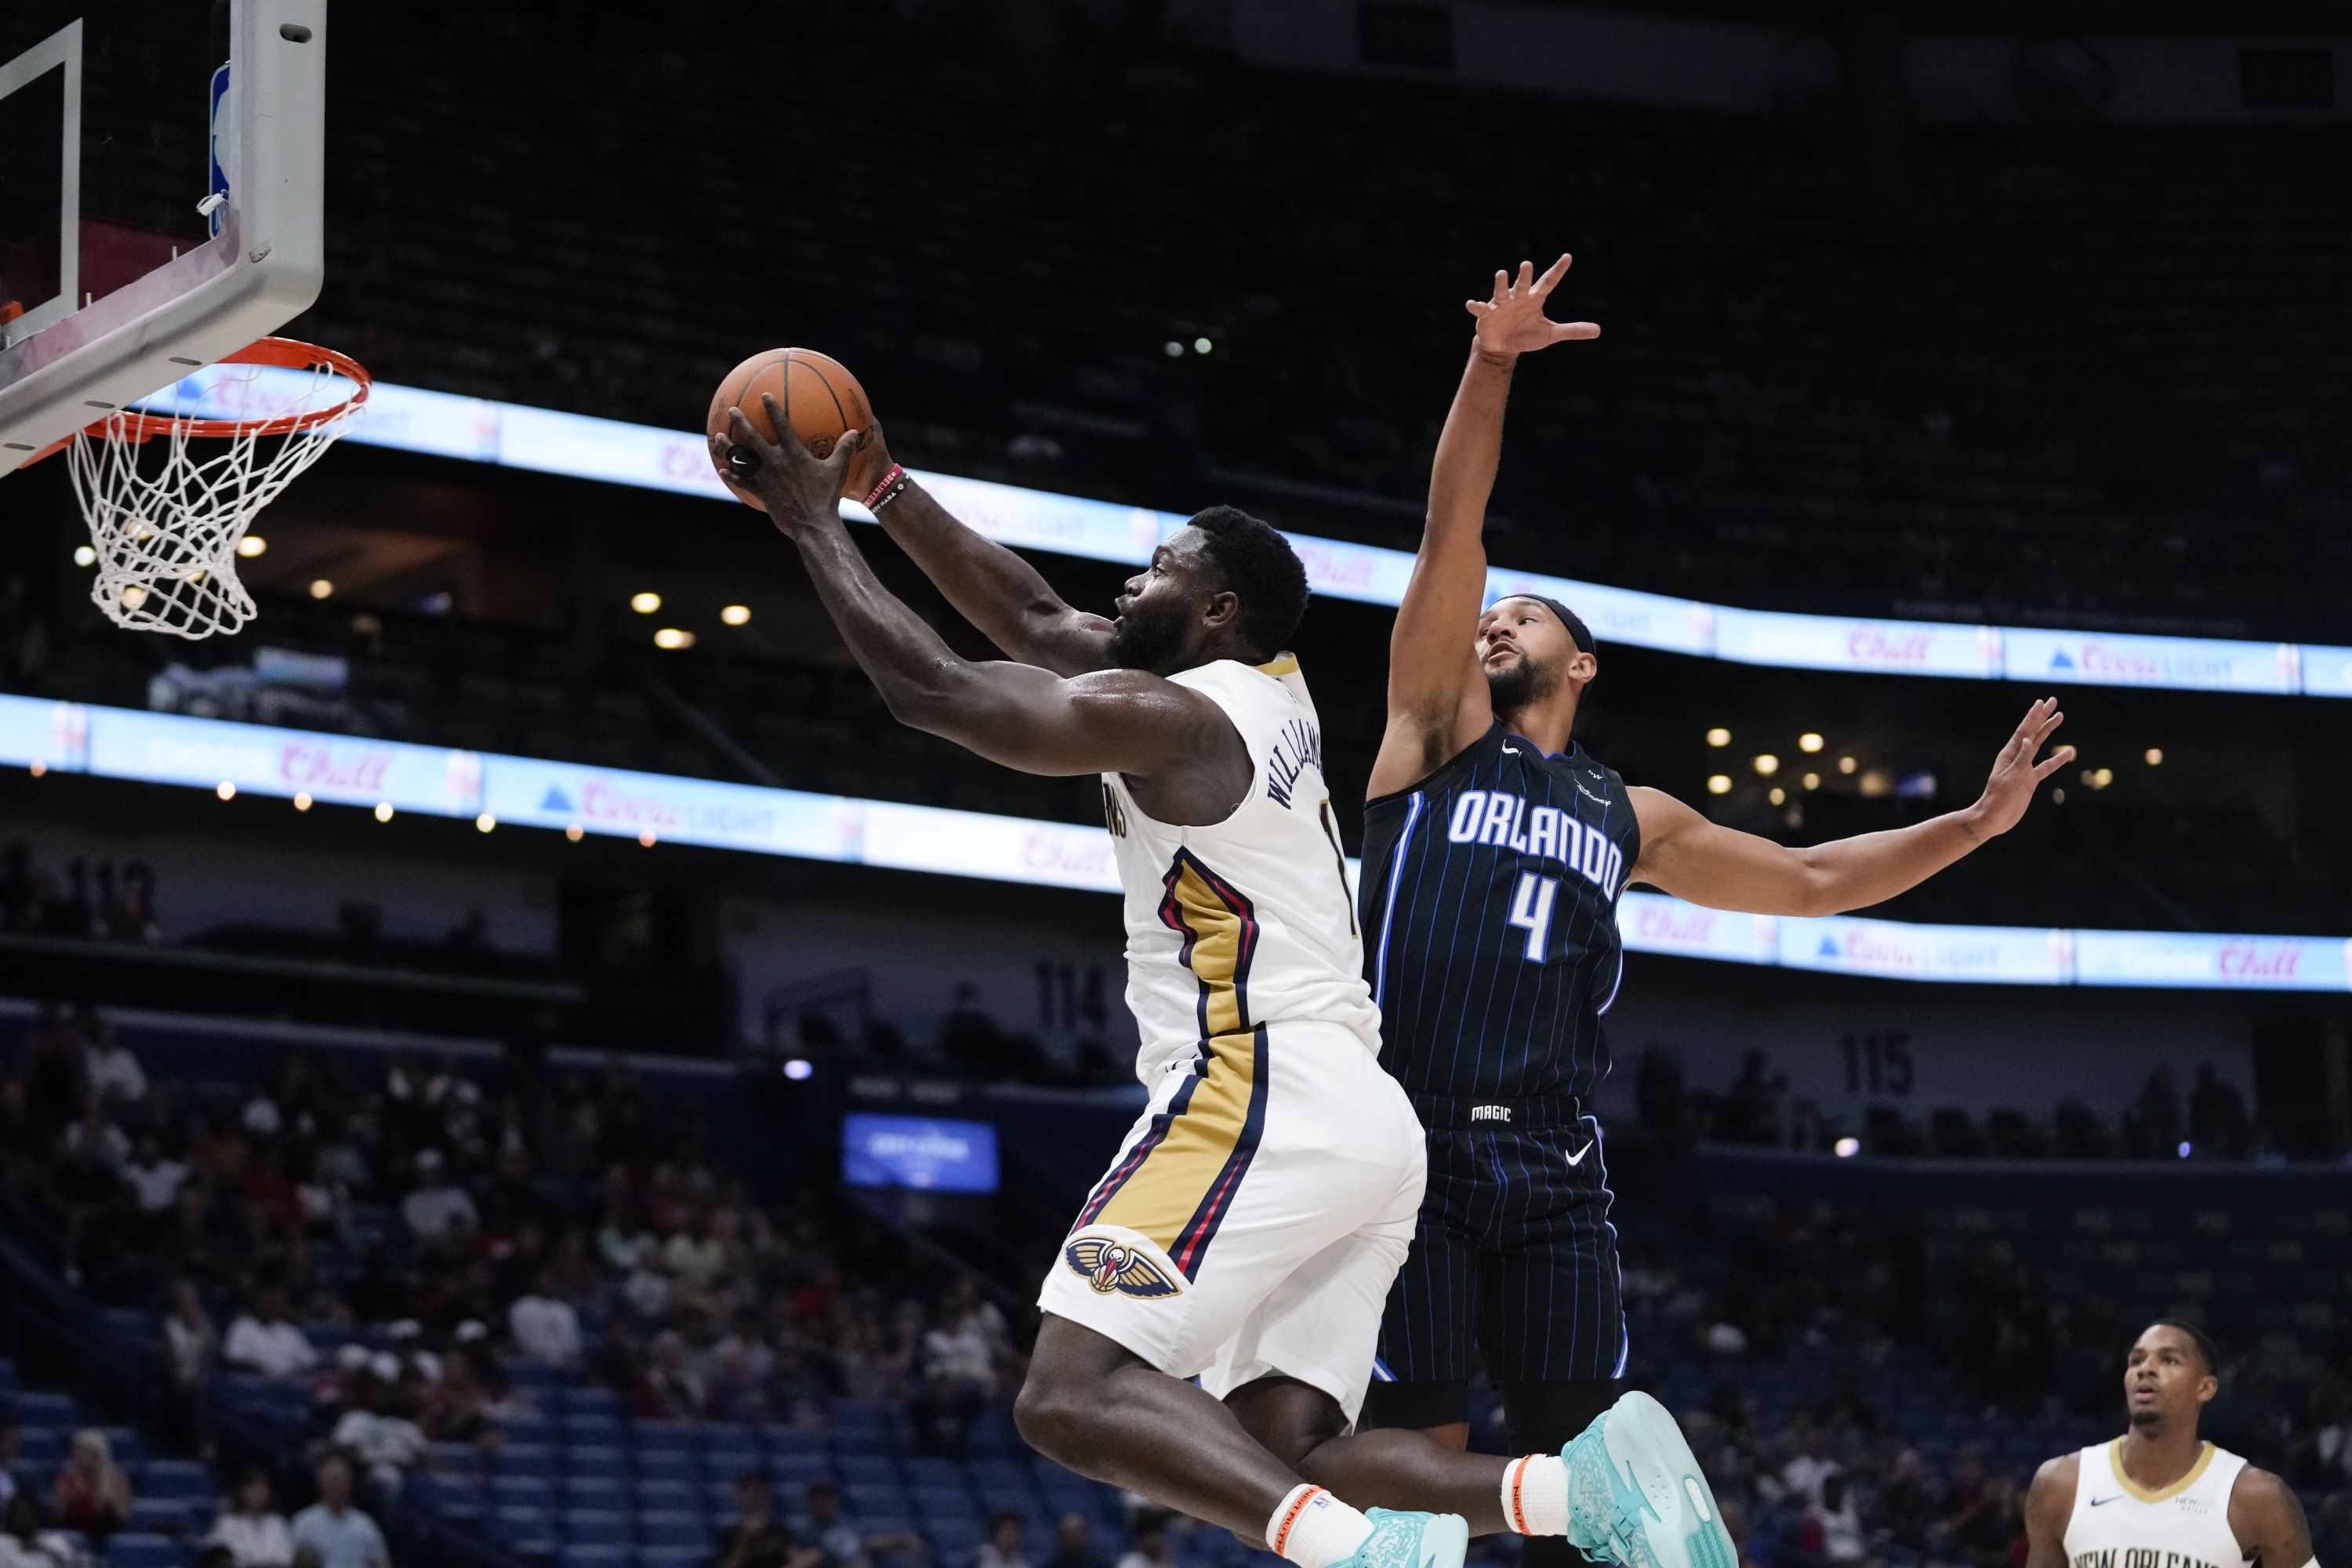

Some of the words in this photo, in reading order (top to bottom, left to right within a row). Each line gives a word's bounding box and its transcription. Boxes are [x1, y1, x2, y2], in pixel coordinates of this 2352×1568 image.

[1449, 789, 1623, 903] ORLANDO
[1507, 869, 1561, 964] 4
[1839, 1033, 1914, 1097] 115
[1471, 1105, 1512, 1123] MAGIC
